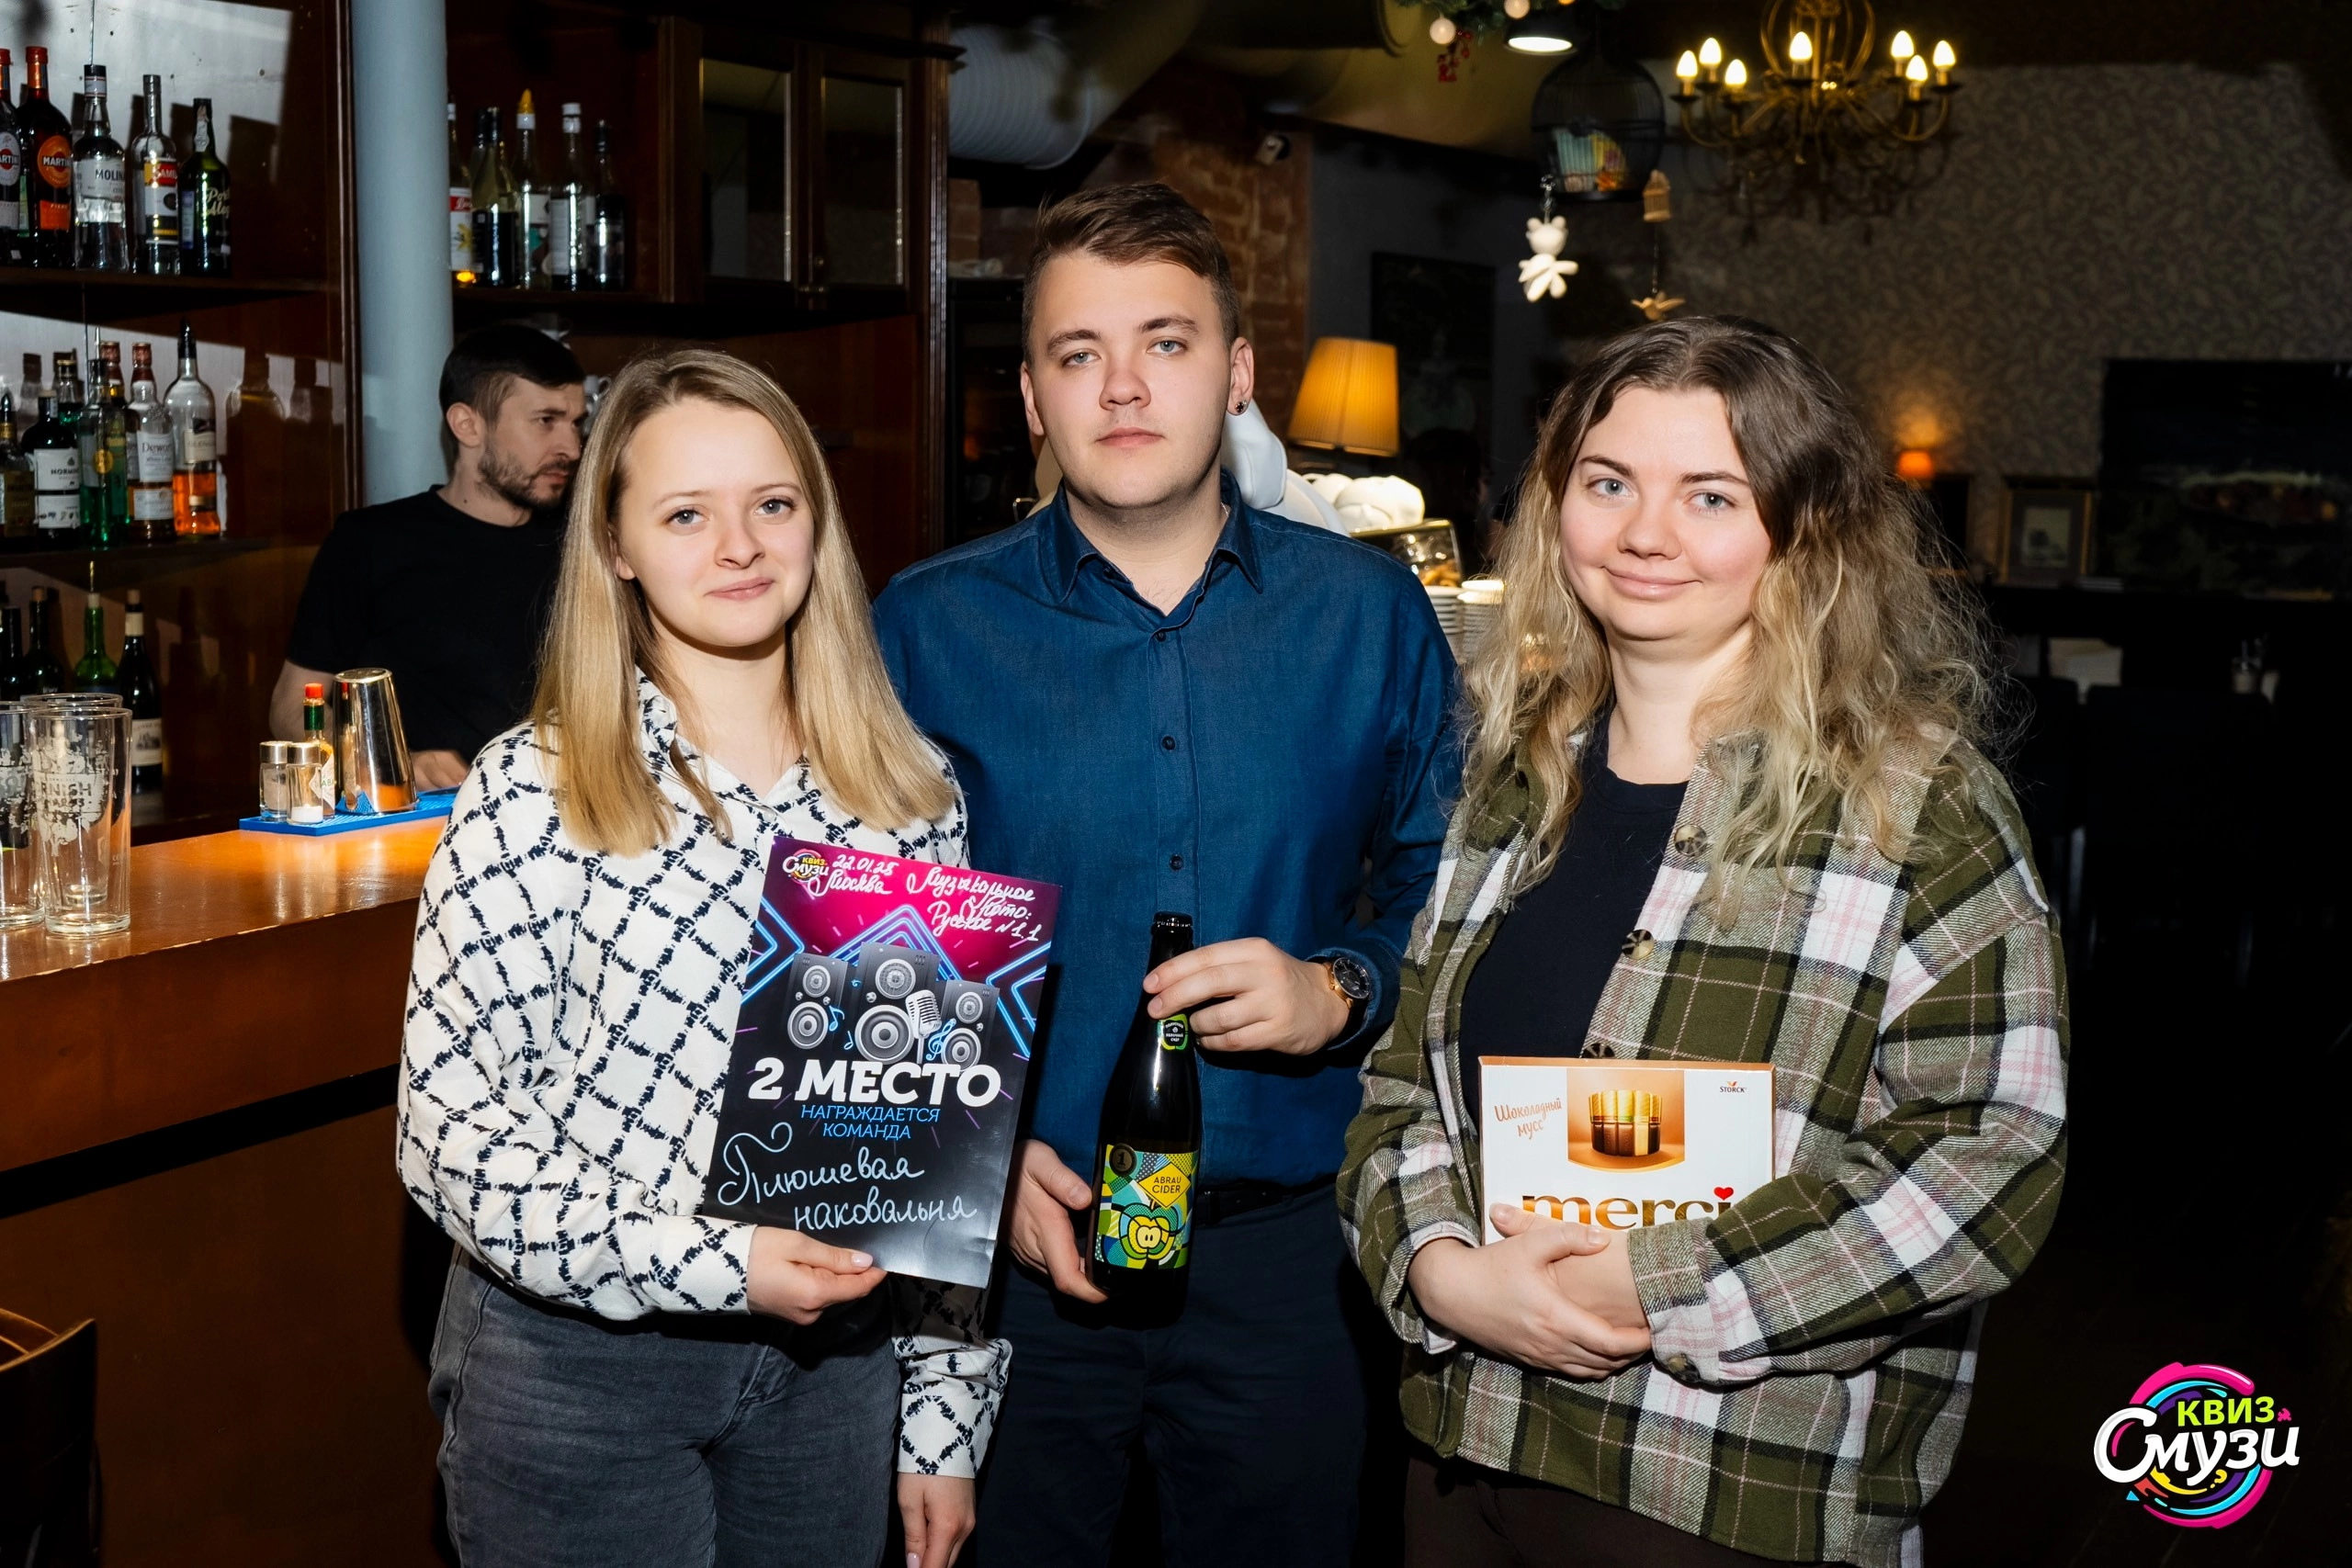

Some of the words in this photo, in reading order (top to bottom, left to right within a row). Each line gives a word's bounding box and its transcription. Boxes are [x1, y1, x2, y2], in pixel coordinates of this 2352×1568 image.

[782, 855, 830, 875] Смузи
[802, 857, 826, 865] КВИЗ
[808, 869, 893, 897] Москва
[748, 1057, 785, 1100] 2
[794, 1058, 1001, 1108] МЕСТО
[801, 1104, 941, 1123] НАГРАЖДАЕТСЯ
[1494, 1098, 1562, 1122] Шоколадный
[823, 1122, 911, 1140] КОМАНДА
[1517, 1119, 1544, 1140] мусс
[718, 1122, 925, 1205] Плюшевая
[1152, 1184, 1181, 1194] CIDER
[1154, 1176, 1182, 1184] ABRAU
[794, 1185, 978, 1231] наковальня
